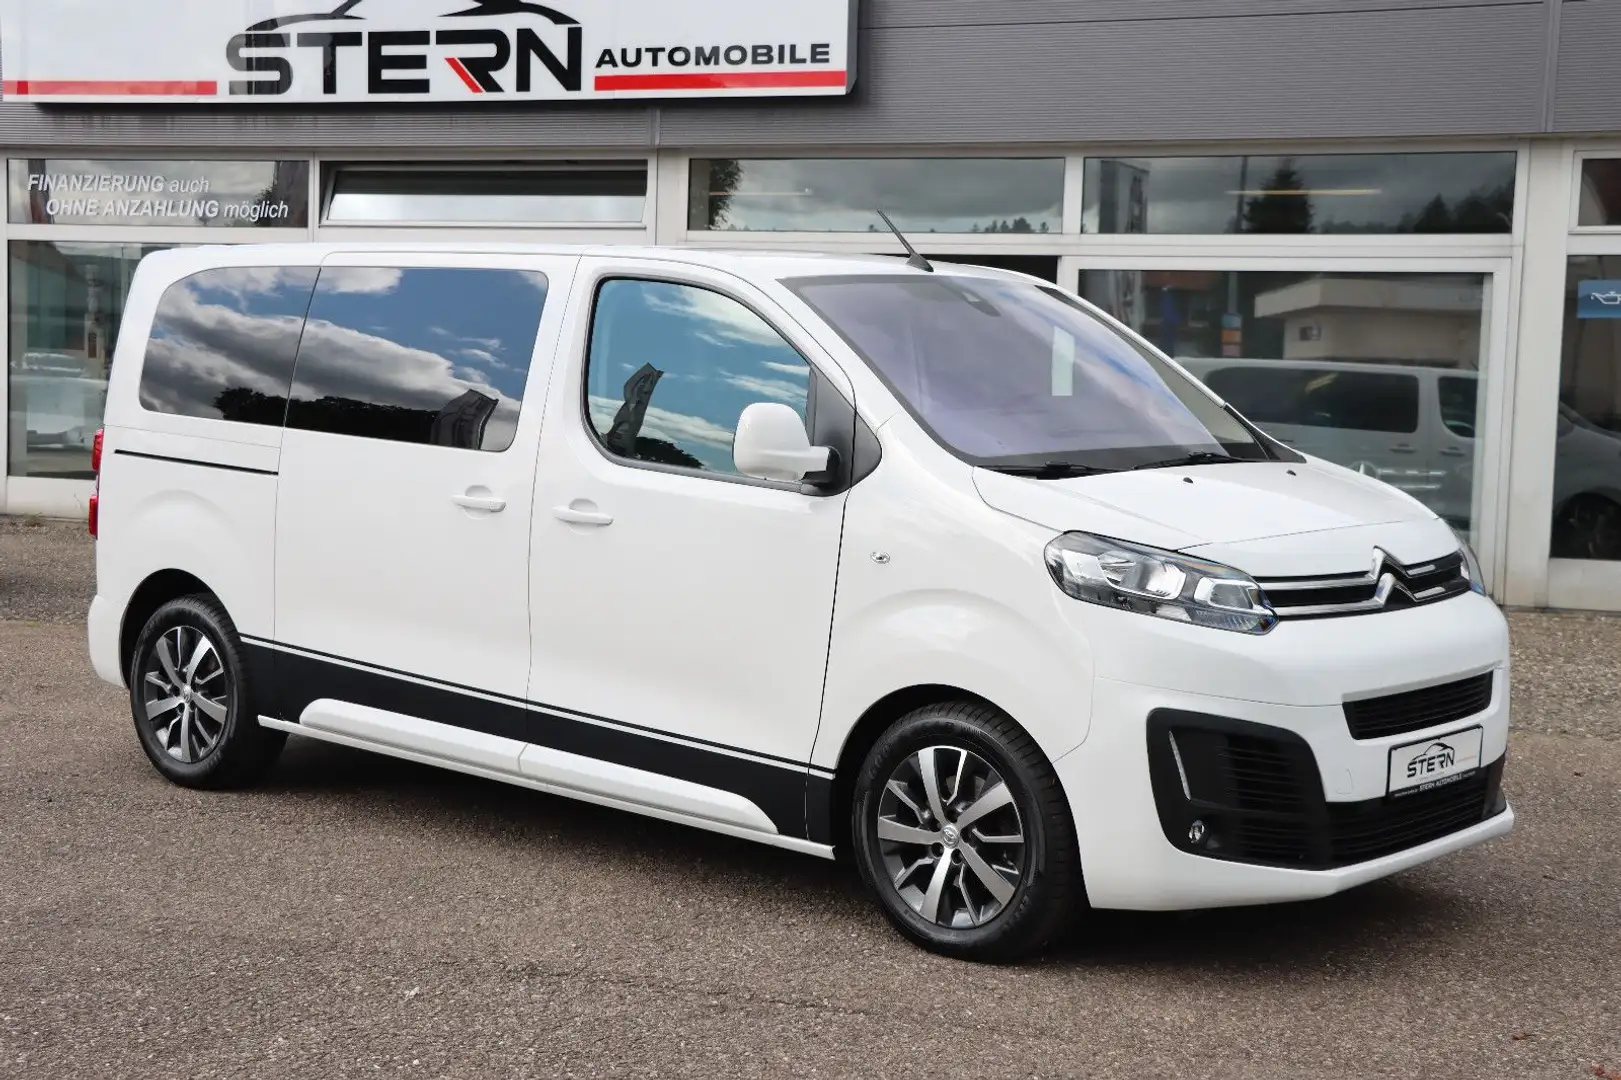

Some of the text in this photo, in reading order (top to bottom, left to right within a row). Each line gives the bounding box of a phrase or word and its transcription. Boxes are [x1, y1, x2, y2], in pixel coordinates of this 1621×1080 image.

[225, 27, 831, 95] STERN AUTOMOBILE
[27, 174, 210, 194] FINANZIERUNG auch
[46, 199, 290, 221] OHNE ANZAHLUNG möglich
[1407, 752, 1455, 778] STERN
